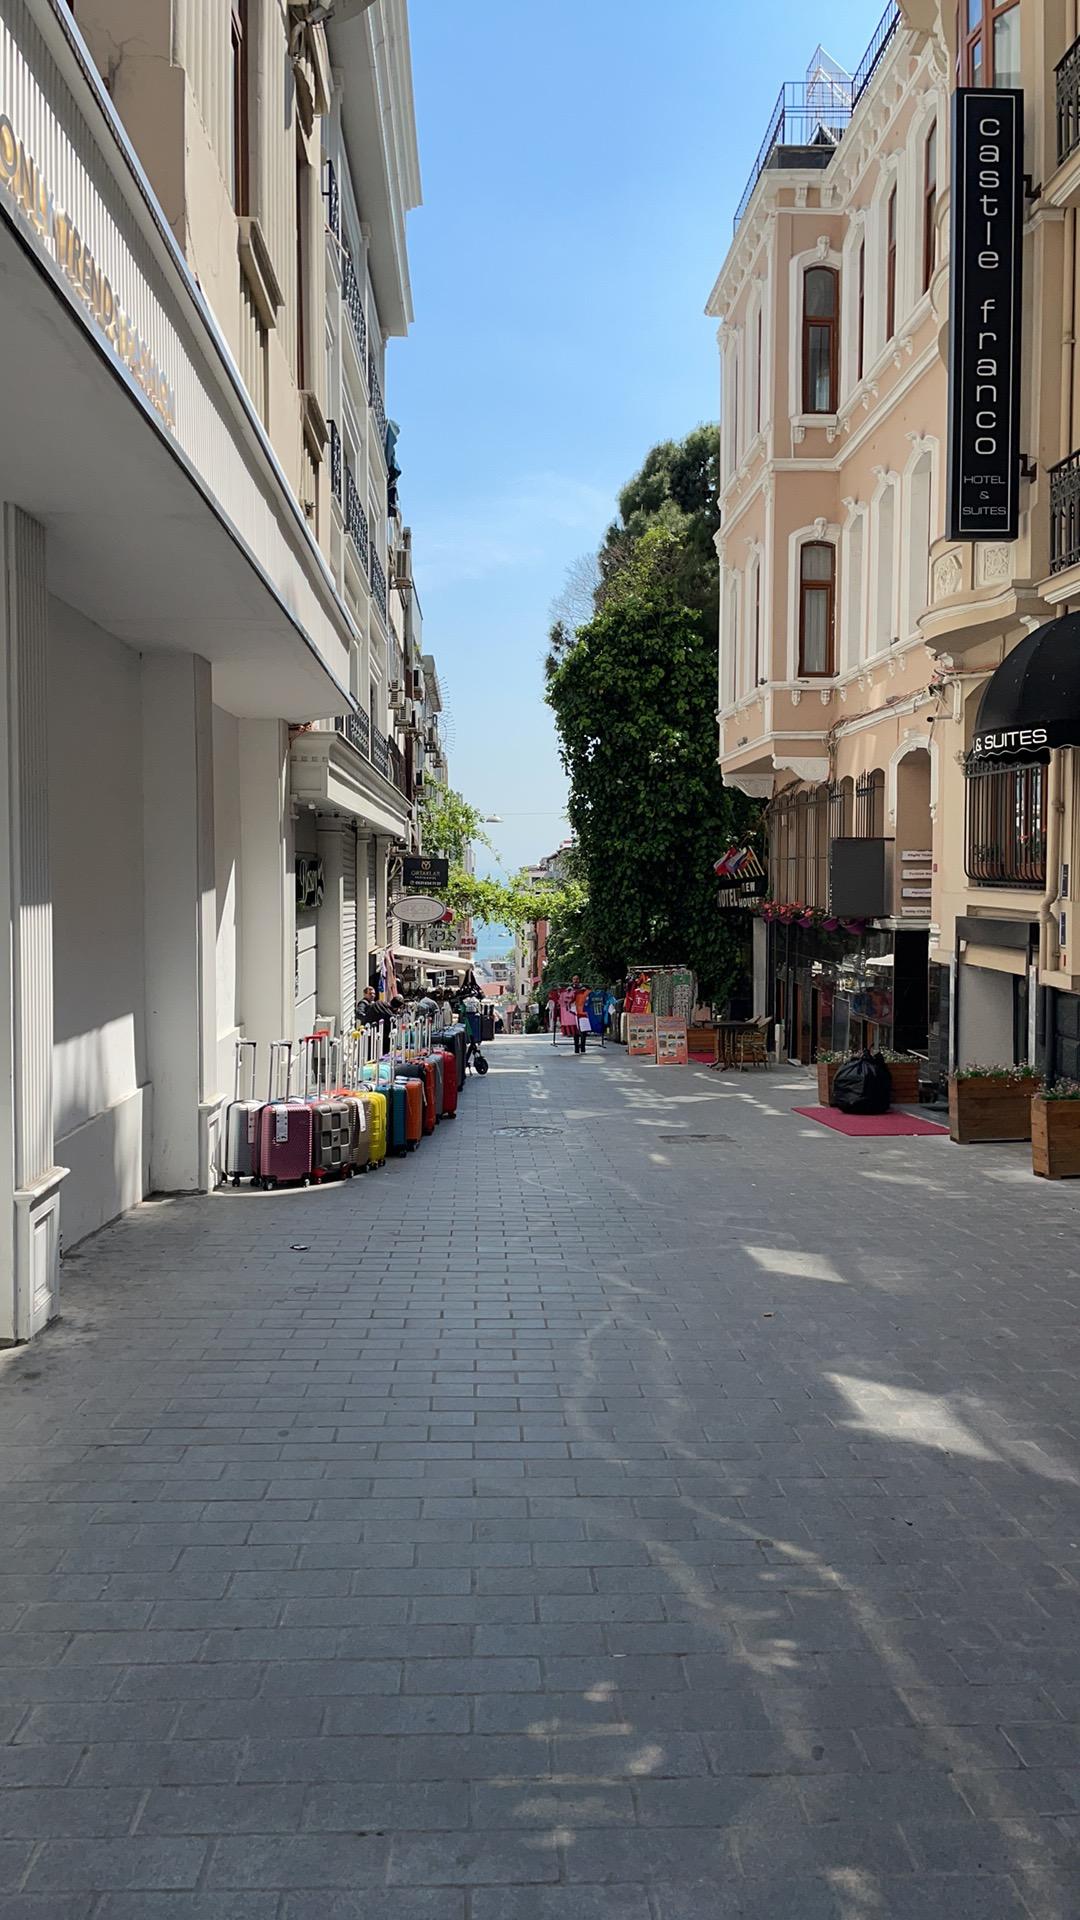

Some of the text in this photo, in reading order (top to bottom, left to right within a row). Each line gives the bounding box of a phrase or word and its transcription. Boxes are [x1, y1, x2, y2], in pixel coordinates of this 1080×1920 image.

[975, 118, 1000, 455] castle franco
[963, 475, 1006, 485] HOTEL
[979, 490, 990, 500] &
[962, 506, 1007, 516] SUITES
[975, 737, 982, 752] &
[984, 728, 1048, 750] SUITES
